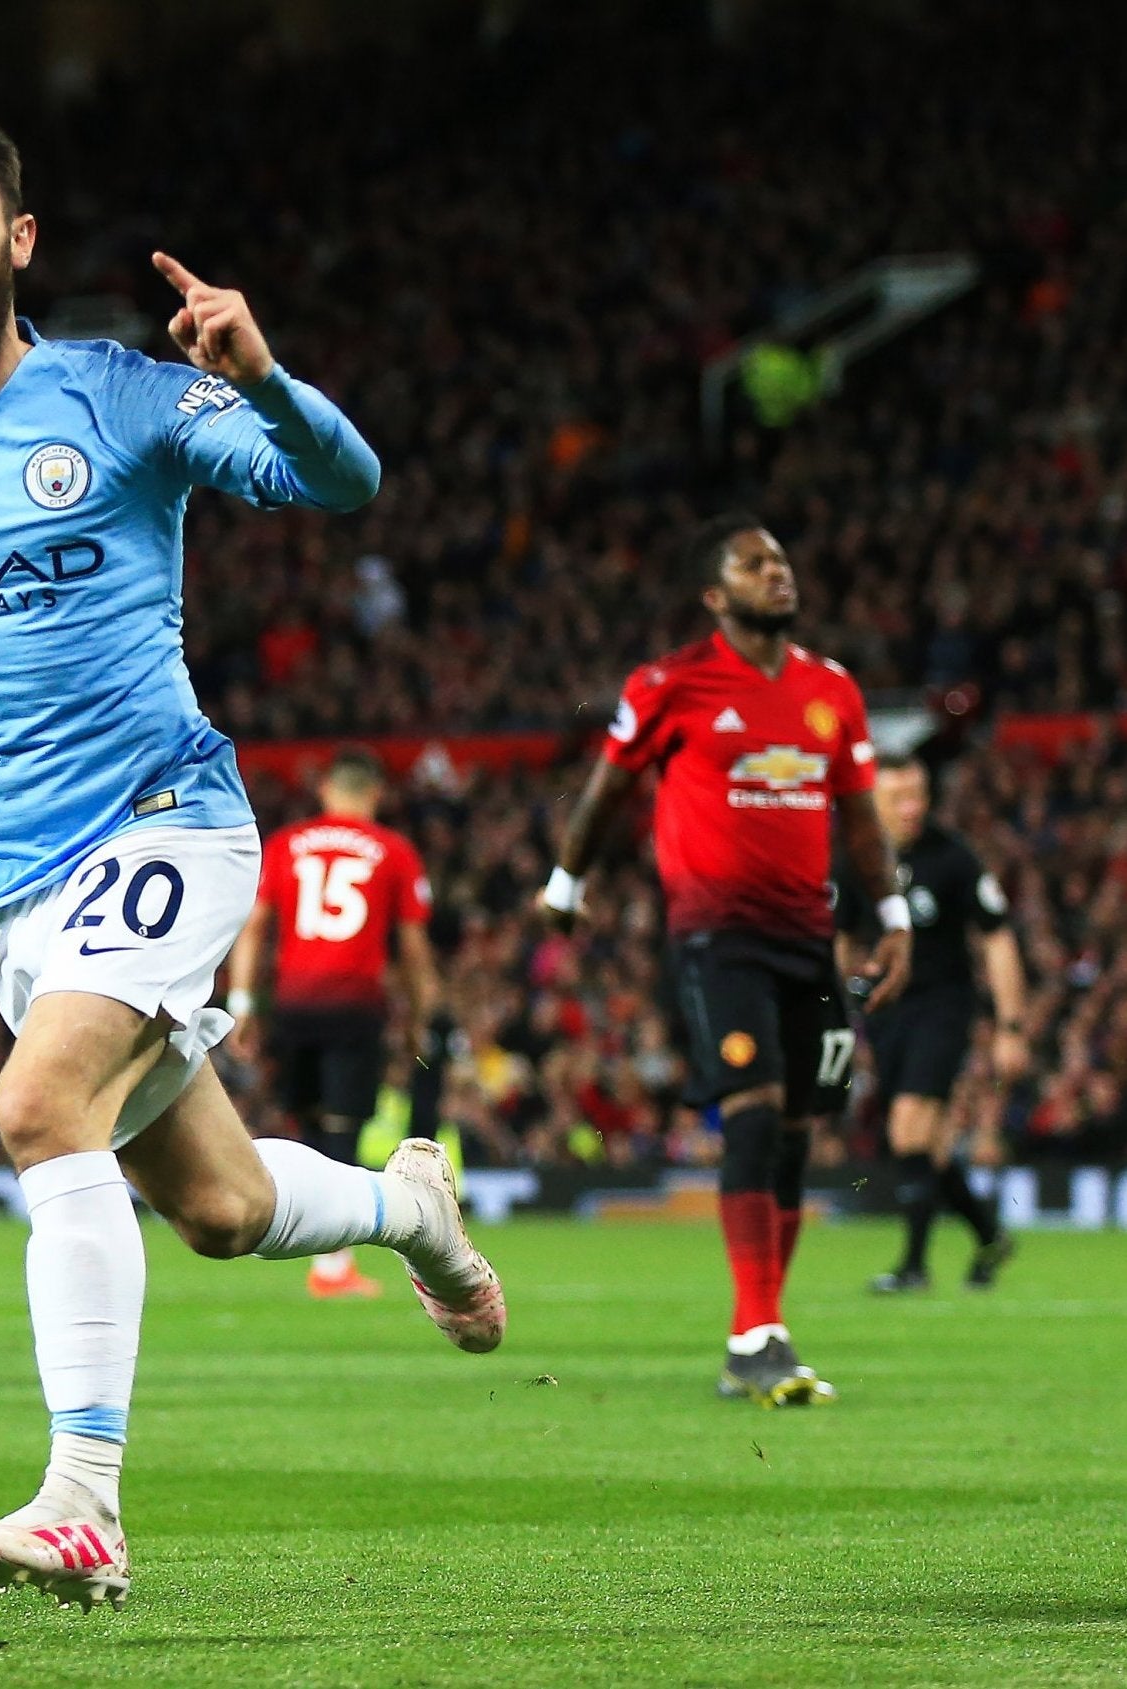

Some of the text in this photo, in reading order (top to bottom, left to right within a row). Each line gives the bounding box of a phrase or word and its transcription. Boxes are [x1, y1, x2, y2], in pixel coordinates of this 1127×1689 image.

[31, 447, 82, 469] MANCHESTER
[61, 856, 185, 940] 20
[293, 855, 369, 942] 15
[817, 1027, 856, 1087] 17
